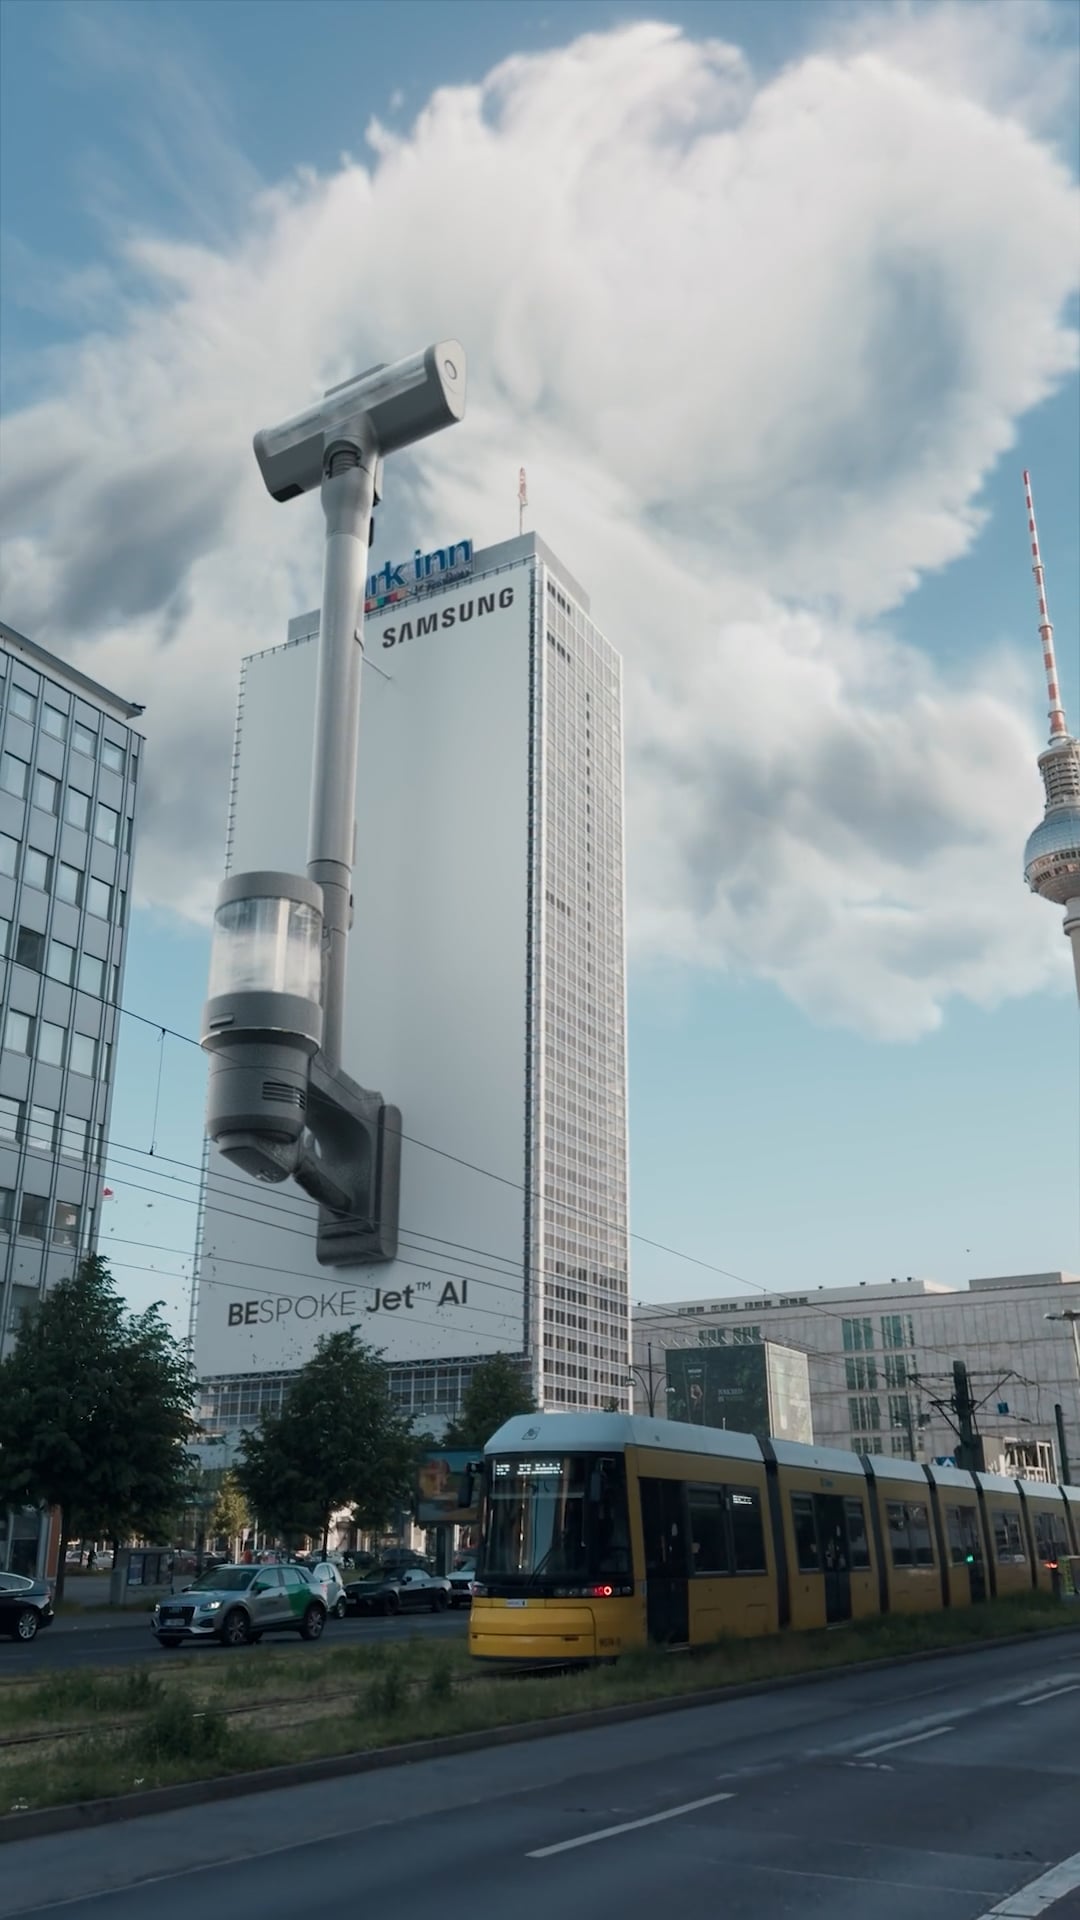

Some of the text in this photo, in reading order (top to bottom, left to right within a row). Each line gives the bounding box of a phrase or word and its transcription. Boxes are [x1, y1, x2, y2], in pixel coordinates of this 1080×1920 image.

[365, 560, 406, 598] rk
[414, 539, 473, 580] inn
[382, 587, 515, 649] SAMSUNG
[228, 1290, 357, 1327] BESPOKE
[438, 1280, 468, 1306] AI
